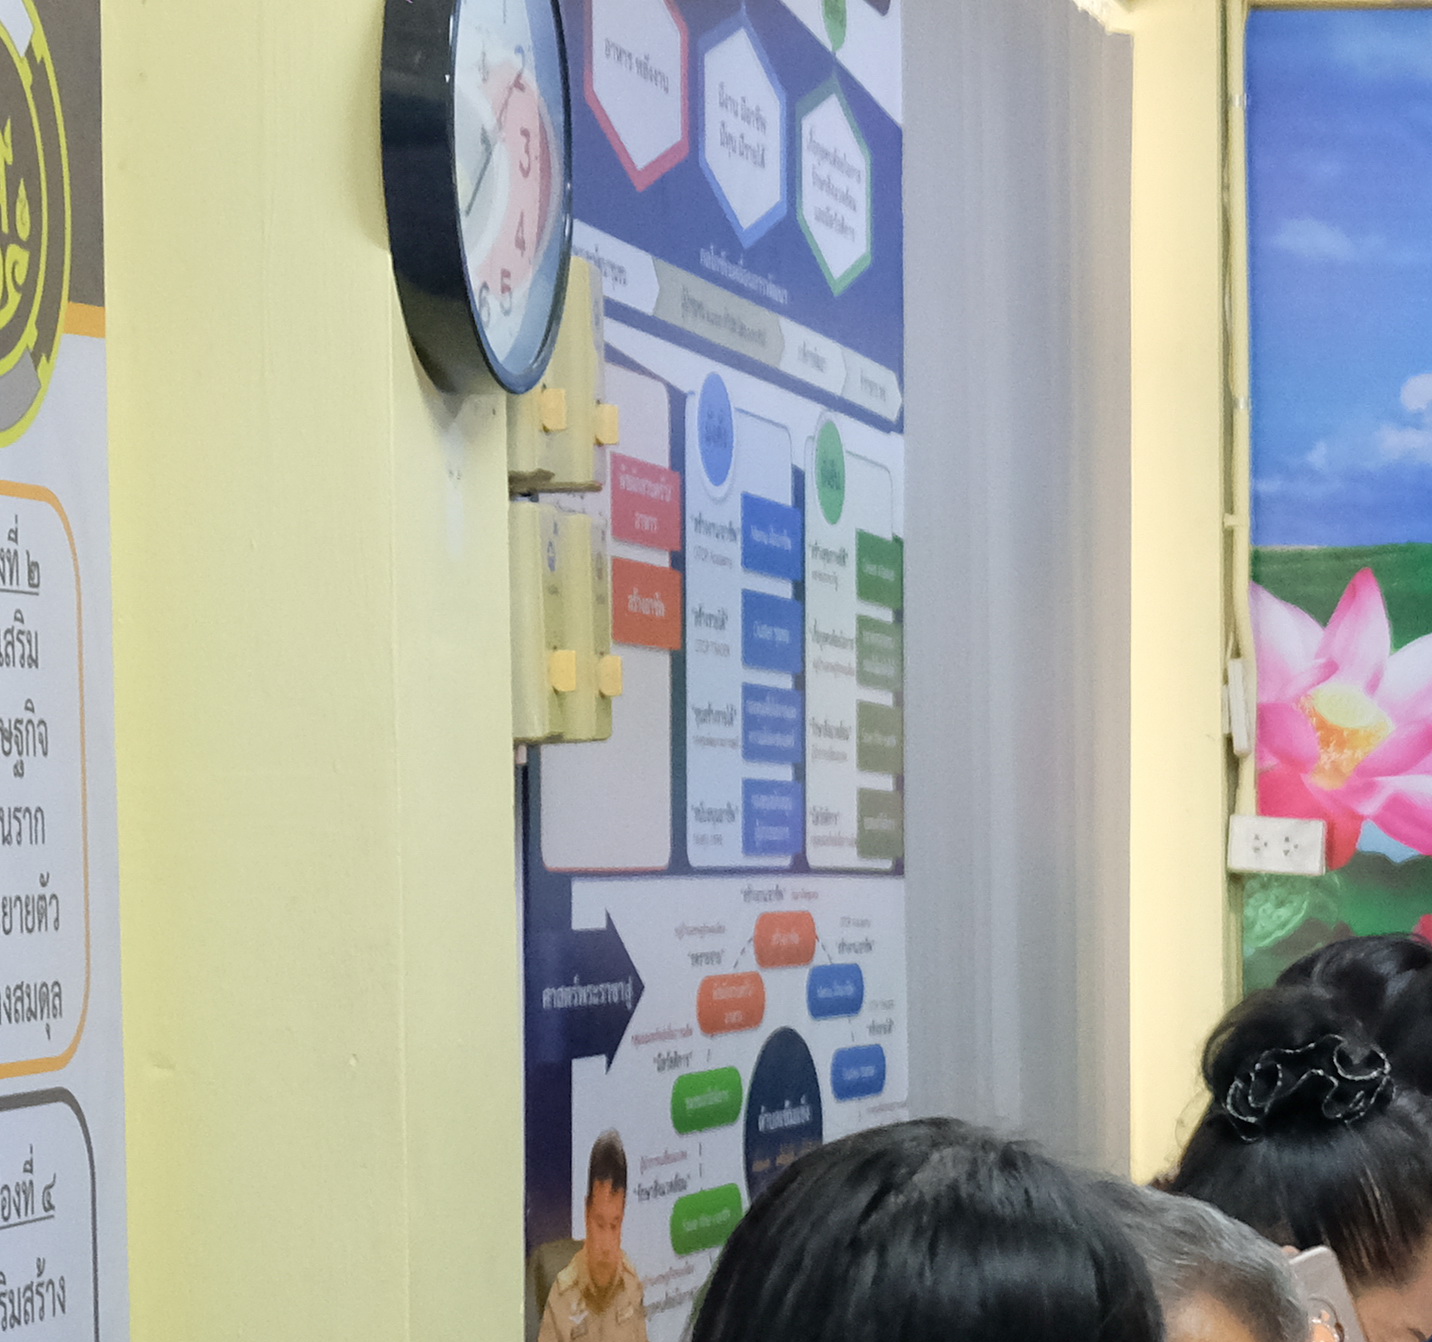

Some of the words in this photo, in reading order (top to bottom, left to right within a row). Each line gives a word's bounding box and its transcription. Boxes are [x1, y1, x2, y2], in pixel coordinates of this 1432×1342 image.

[519, 128, 531, 179] 3
[513, 211, 526, 257] 4
[478, 281, 491, 329] 6
[500, 268, 513, 317] 5
[1, 872, 60, 936] ยายตัว
[0, 980, 63, 1041] งสมดุล
[0, 1144, 35, 1222] องที่
